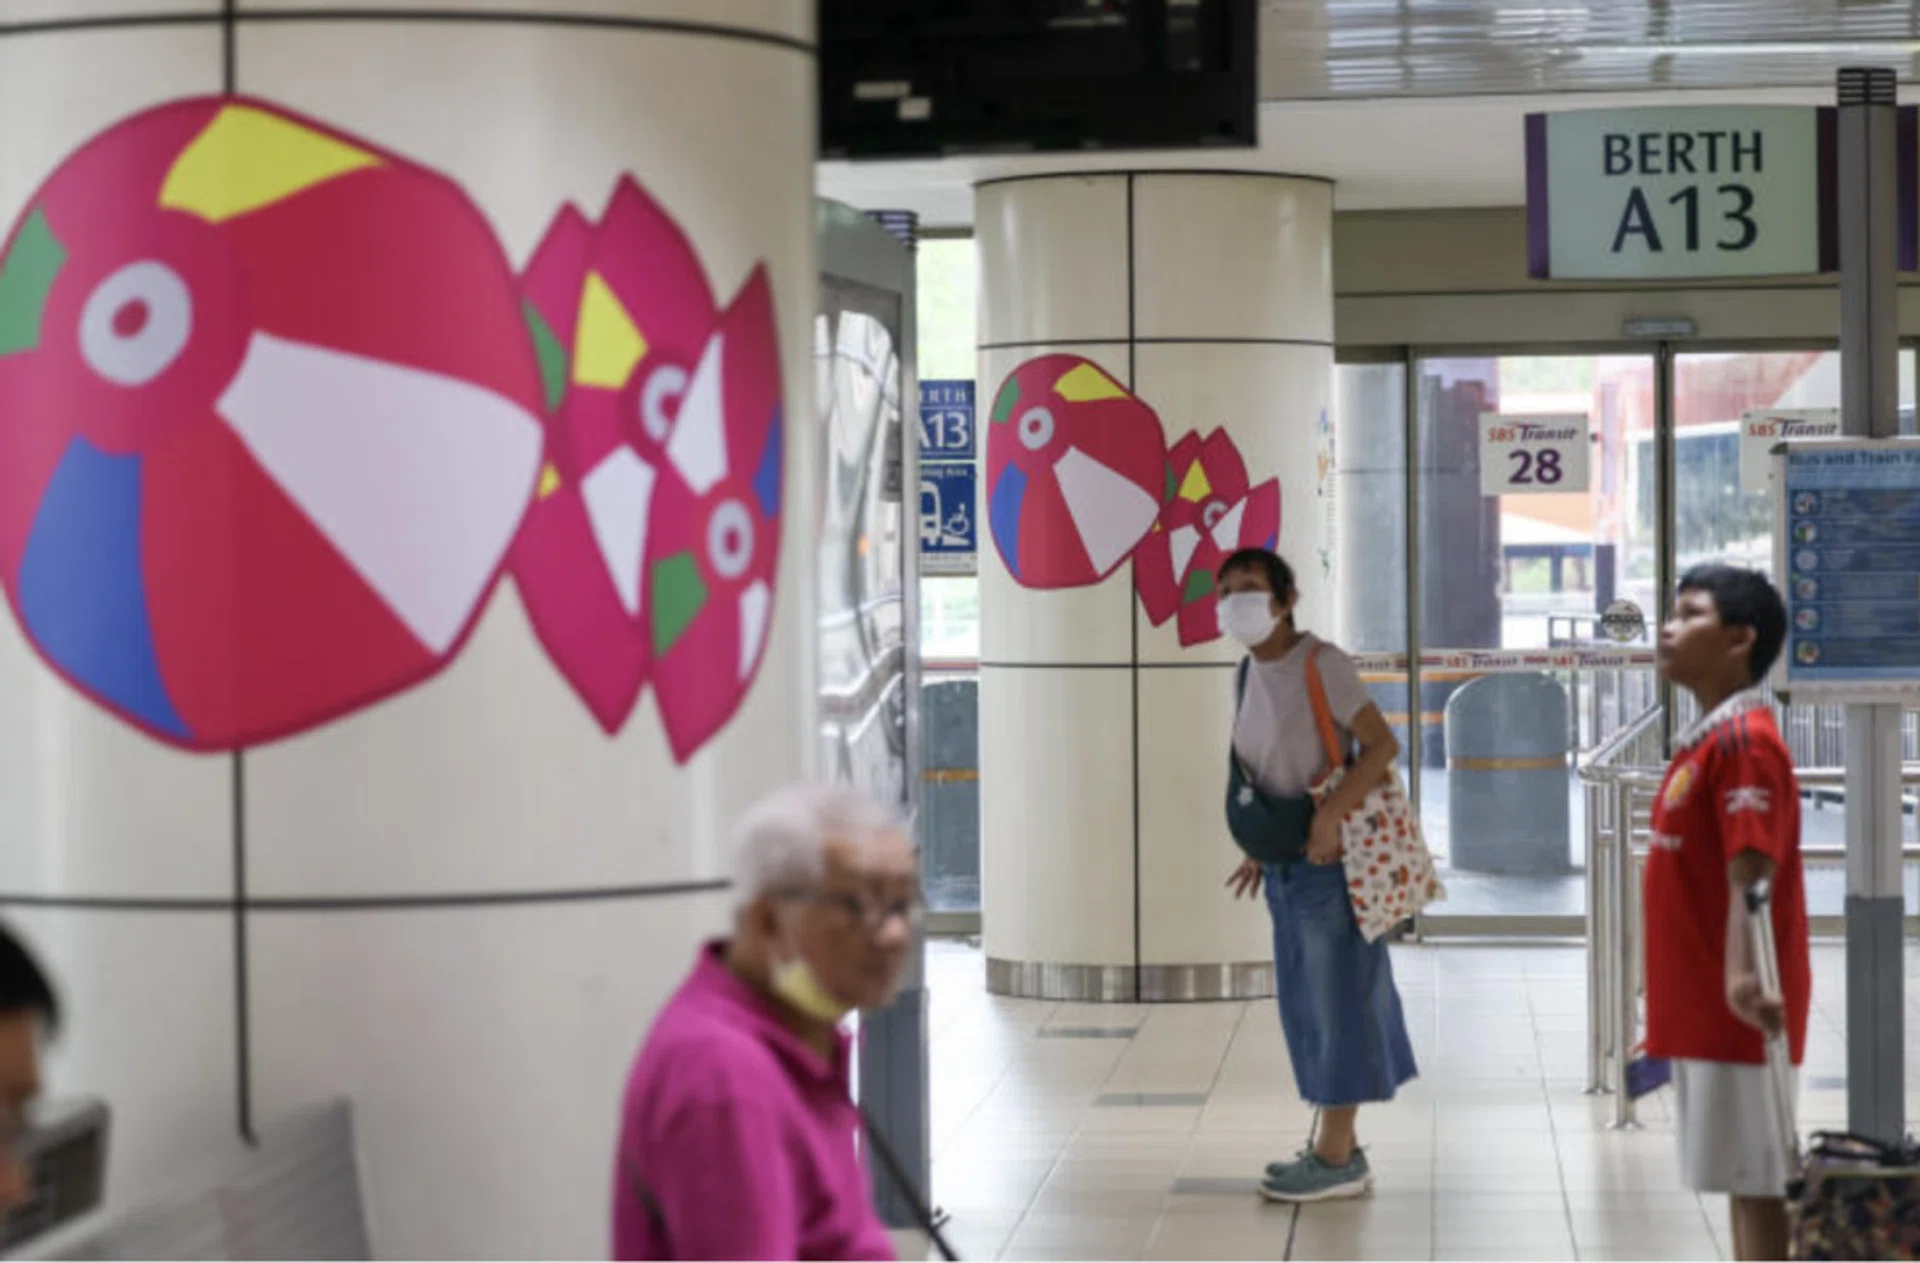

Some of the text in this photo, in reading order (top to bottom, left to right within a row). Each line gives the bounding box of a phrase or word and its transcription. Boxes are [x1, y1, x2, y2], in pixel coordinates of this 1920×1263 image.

[1603, 130, 1764, 175] BERTH
[1610, 184, 1758, 253] A13
[919, 389, 967, 403] RTH
[1488, 423, 1578, 442] SBS Transit
[1748, 420, 1838, 438] SBS Transit
[1508, 448, 1563, 484] 28
